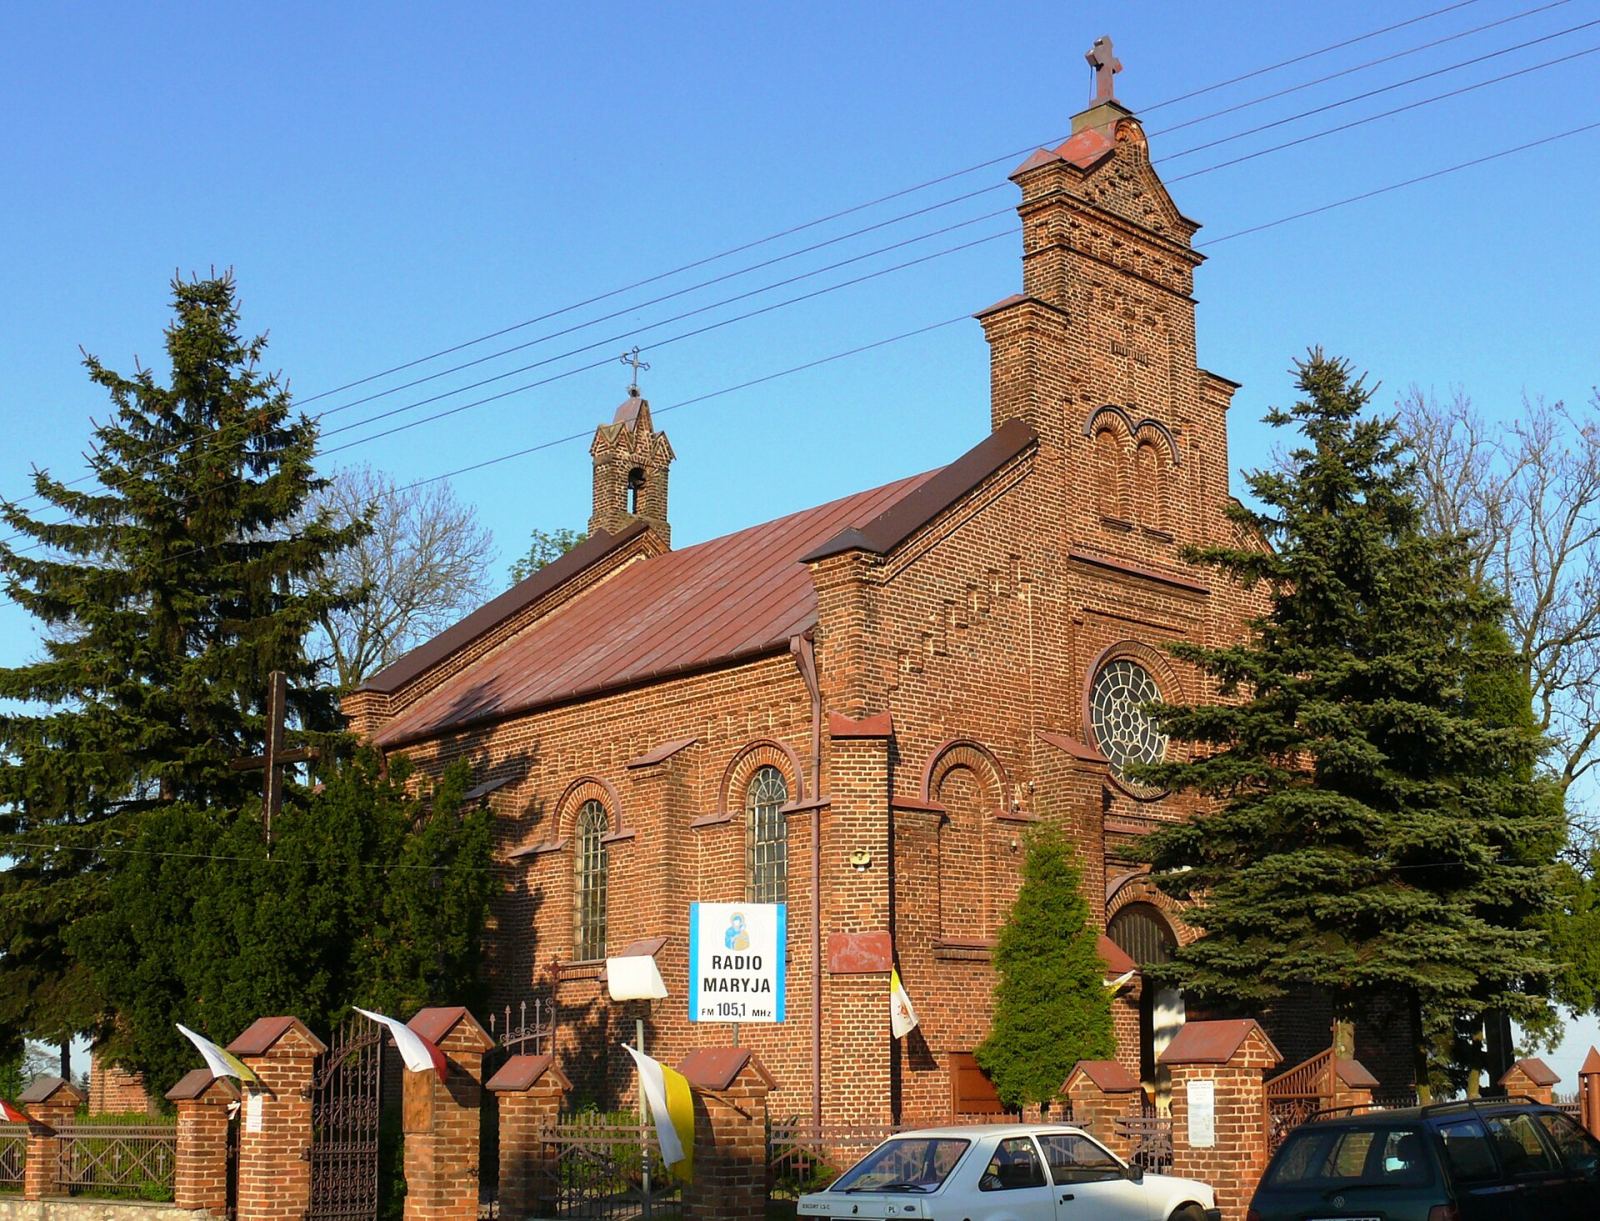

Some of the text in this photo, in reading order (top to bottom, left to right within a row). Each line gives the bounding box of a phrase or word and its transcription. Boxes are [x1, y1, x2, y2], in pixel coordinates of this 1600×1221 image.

[712, 955, 762, 970] RADIO
[703, 977, 771, 993] MARYJA
[701, 1002, 772, 1018] FM 105,1 MHz
[888, 1206, 896, 1214] PL
